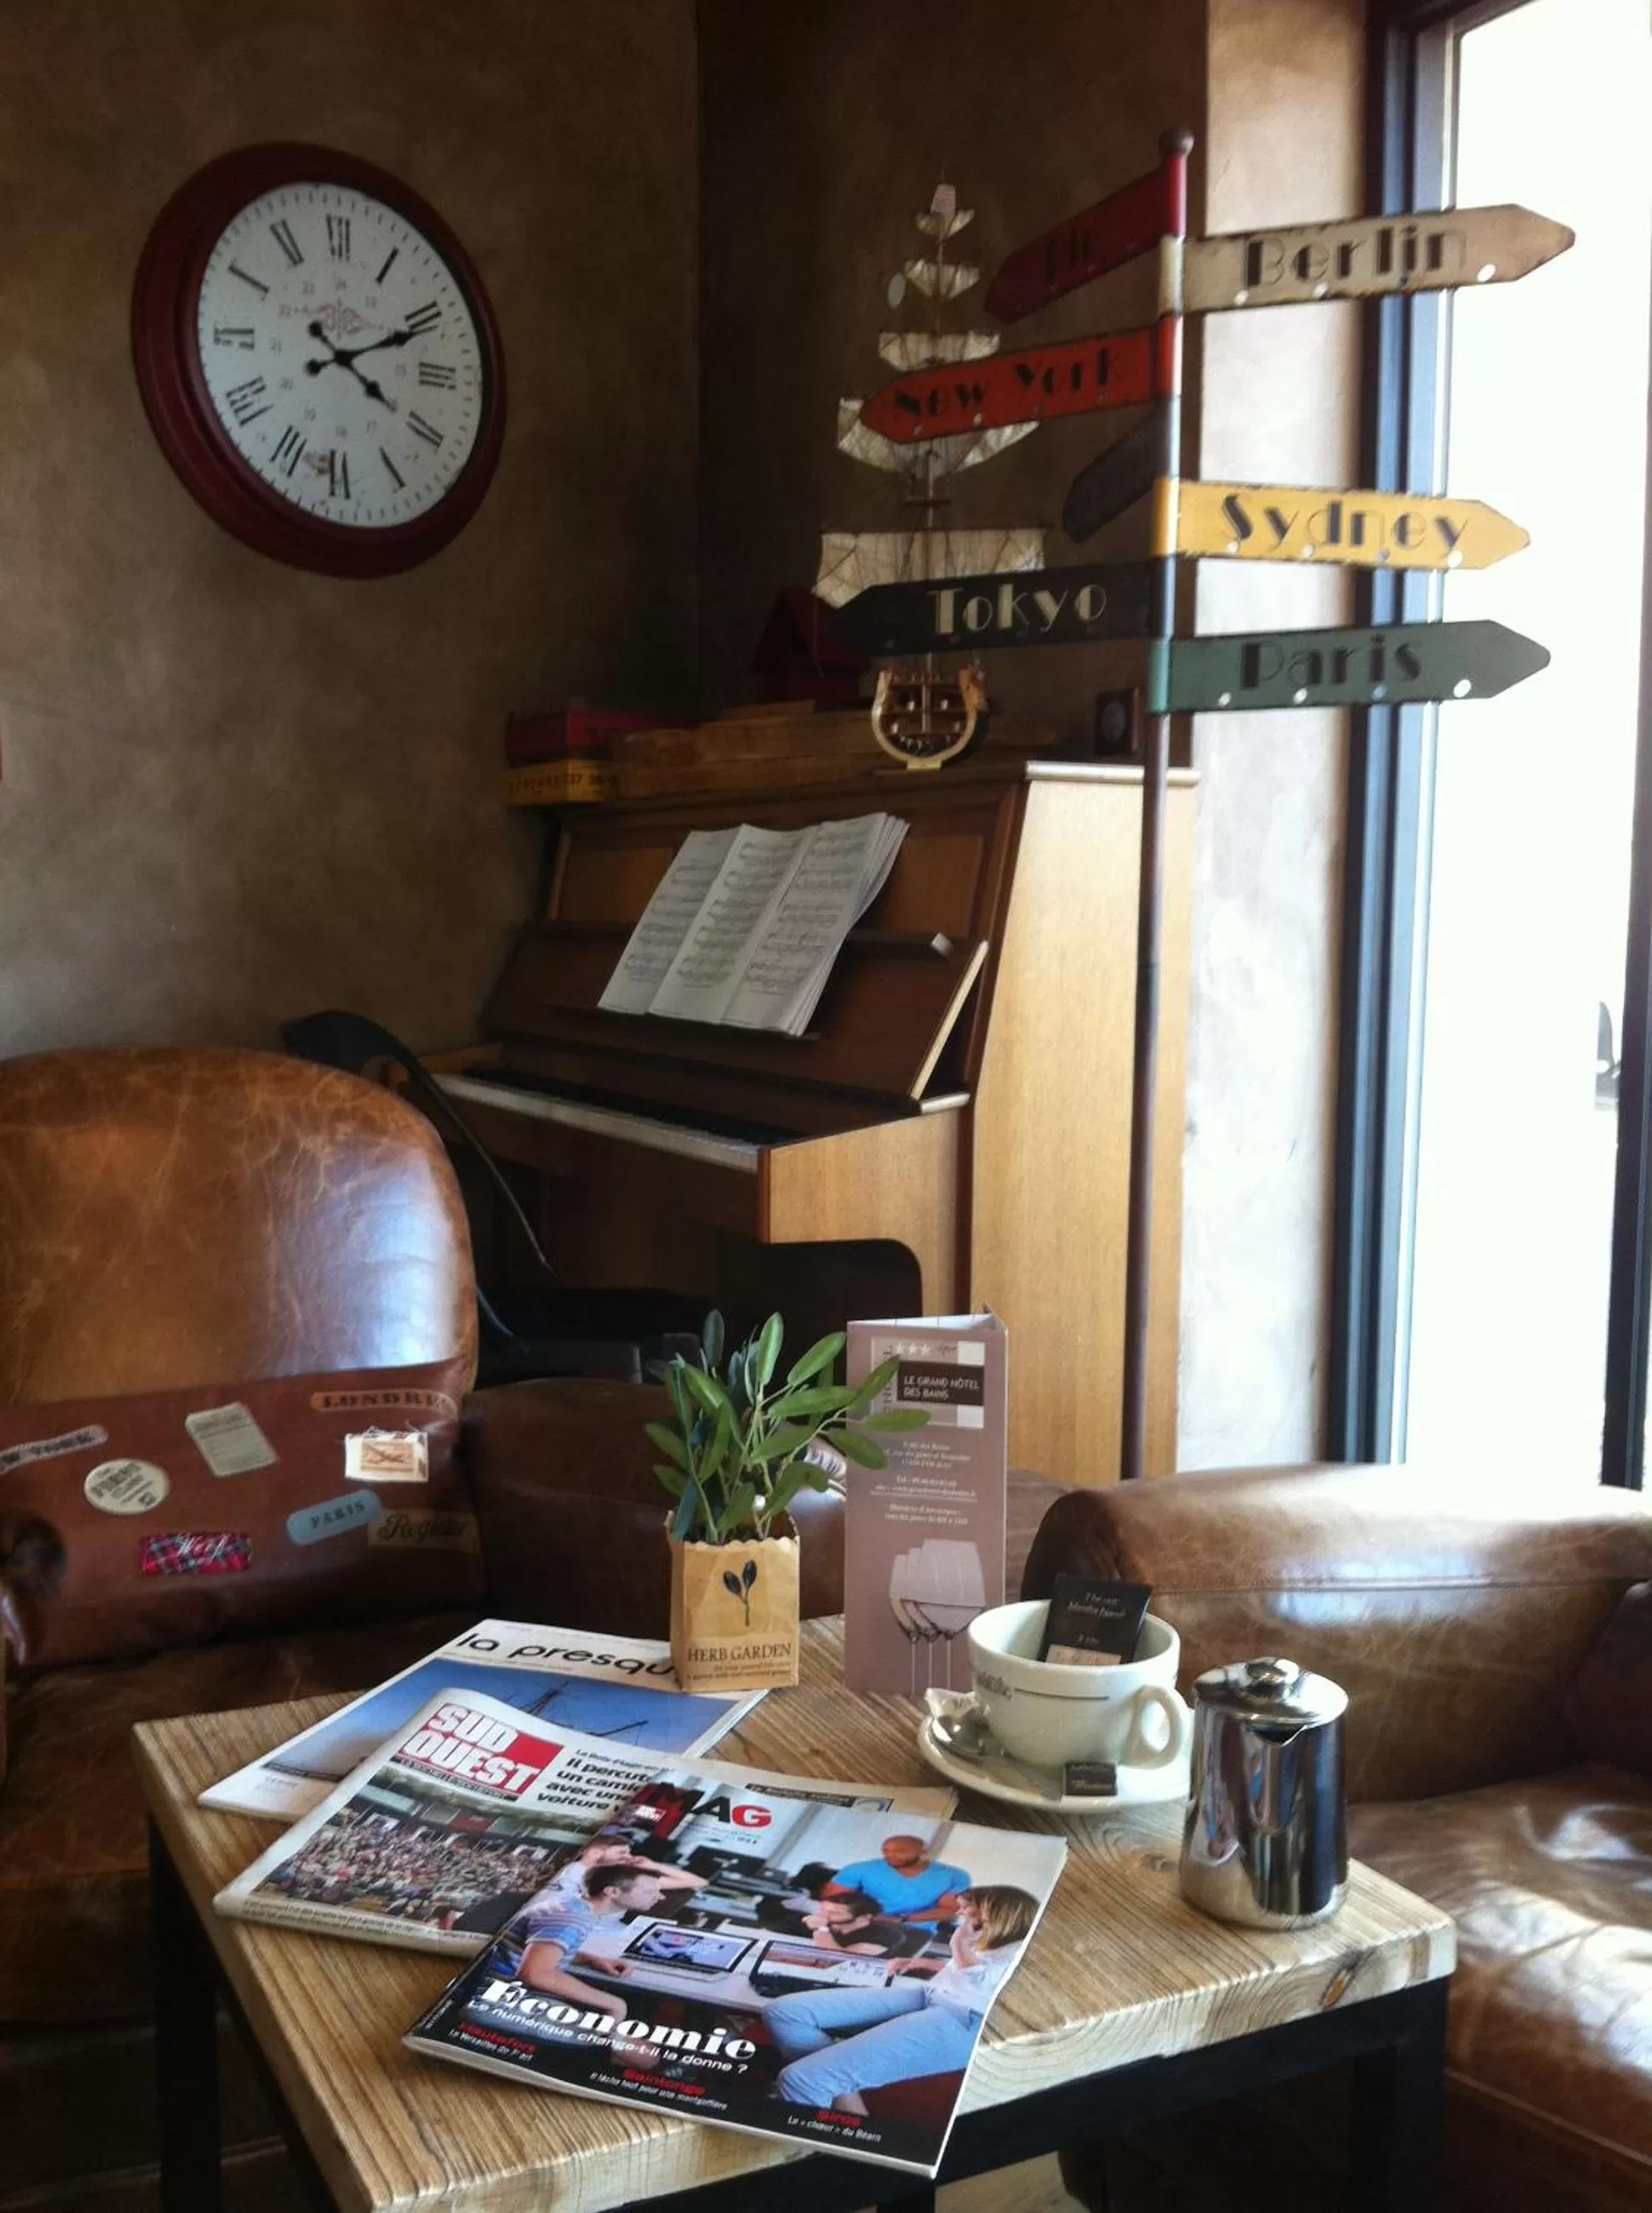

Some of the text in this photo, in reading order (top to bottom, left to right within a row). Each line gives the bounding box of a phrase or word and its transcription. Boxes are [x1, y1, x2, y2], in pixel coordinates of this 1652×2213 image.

[1242, 225, 1468, 289] Berlin
[894, 380, 984, 417] New
[1221, 494, 1469, 558] Sydney
[925, 584, 1107, 634] Tokyo
[1238, 634, 1422, 688] Paris
[903, 1375, 981, 1392] LE GRAND HÔTEL
[310, 1500, 365, 1530] PARIS
[455, 1632, 499, 1652] la
[686, 1642, 791, 1663] HERB GARDEN
[428, 1704, 519, 1753] SUD
[402, 1729, 540, 1791] OUEST
[556, 1770, 583, 1783] un
[537, 1792, 610, 1810] voiture
[546, 1782, 595, 1796] avec
[467, 1999, 490, 2013] Le
[492, 2008, 575, 2038] numérique
[662, 2050, 679, 2061] la
[680, 2054, 733, 2072] donne
[481, 1977, 756, 2060] Économie
